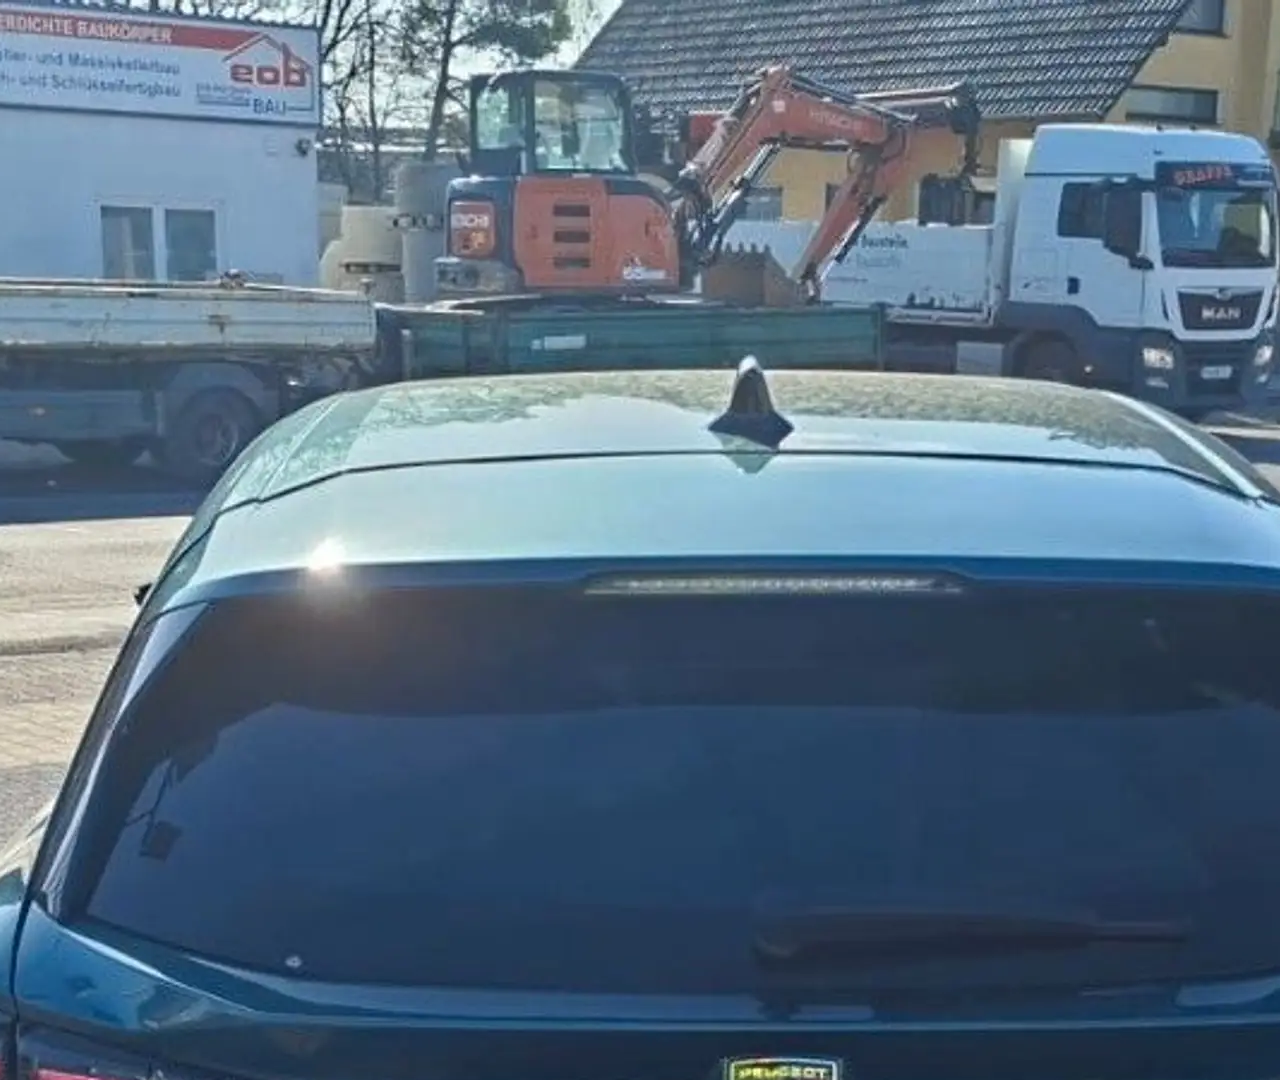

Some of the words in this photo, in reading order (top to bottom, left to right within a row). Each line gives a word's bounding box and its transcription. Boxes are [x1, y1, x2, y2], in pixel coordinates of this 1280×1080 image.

[77, 22, 173, 43] BAUKÖRPER
[230, 42, 307, 87] eob
[253, 98, 286, 115] BAU
[1201, 305, 1241, 320] MAN
[738, 1065, 828, 1079] PEUGEOT
